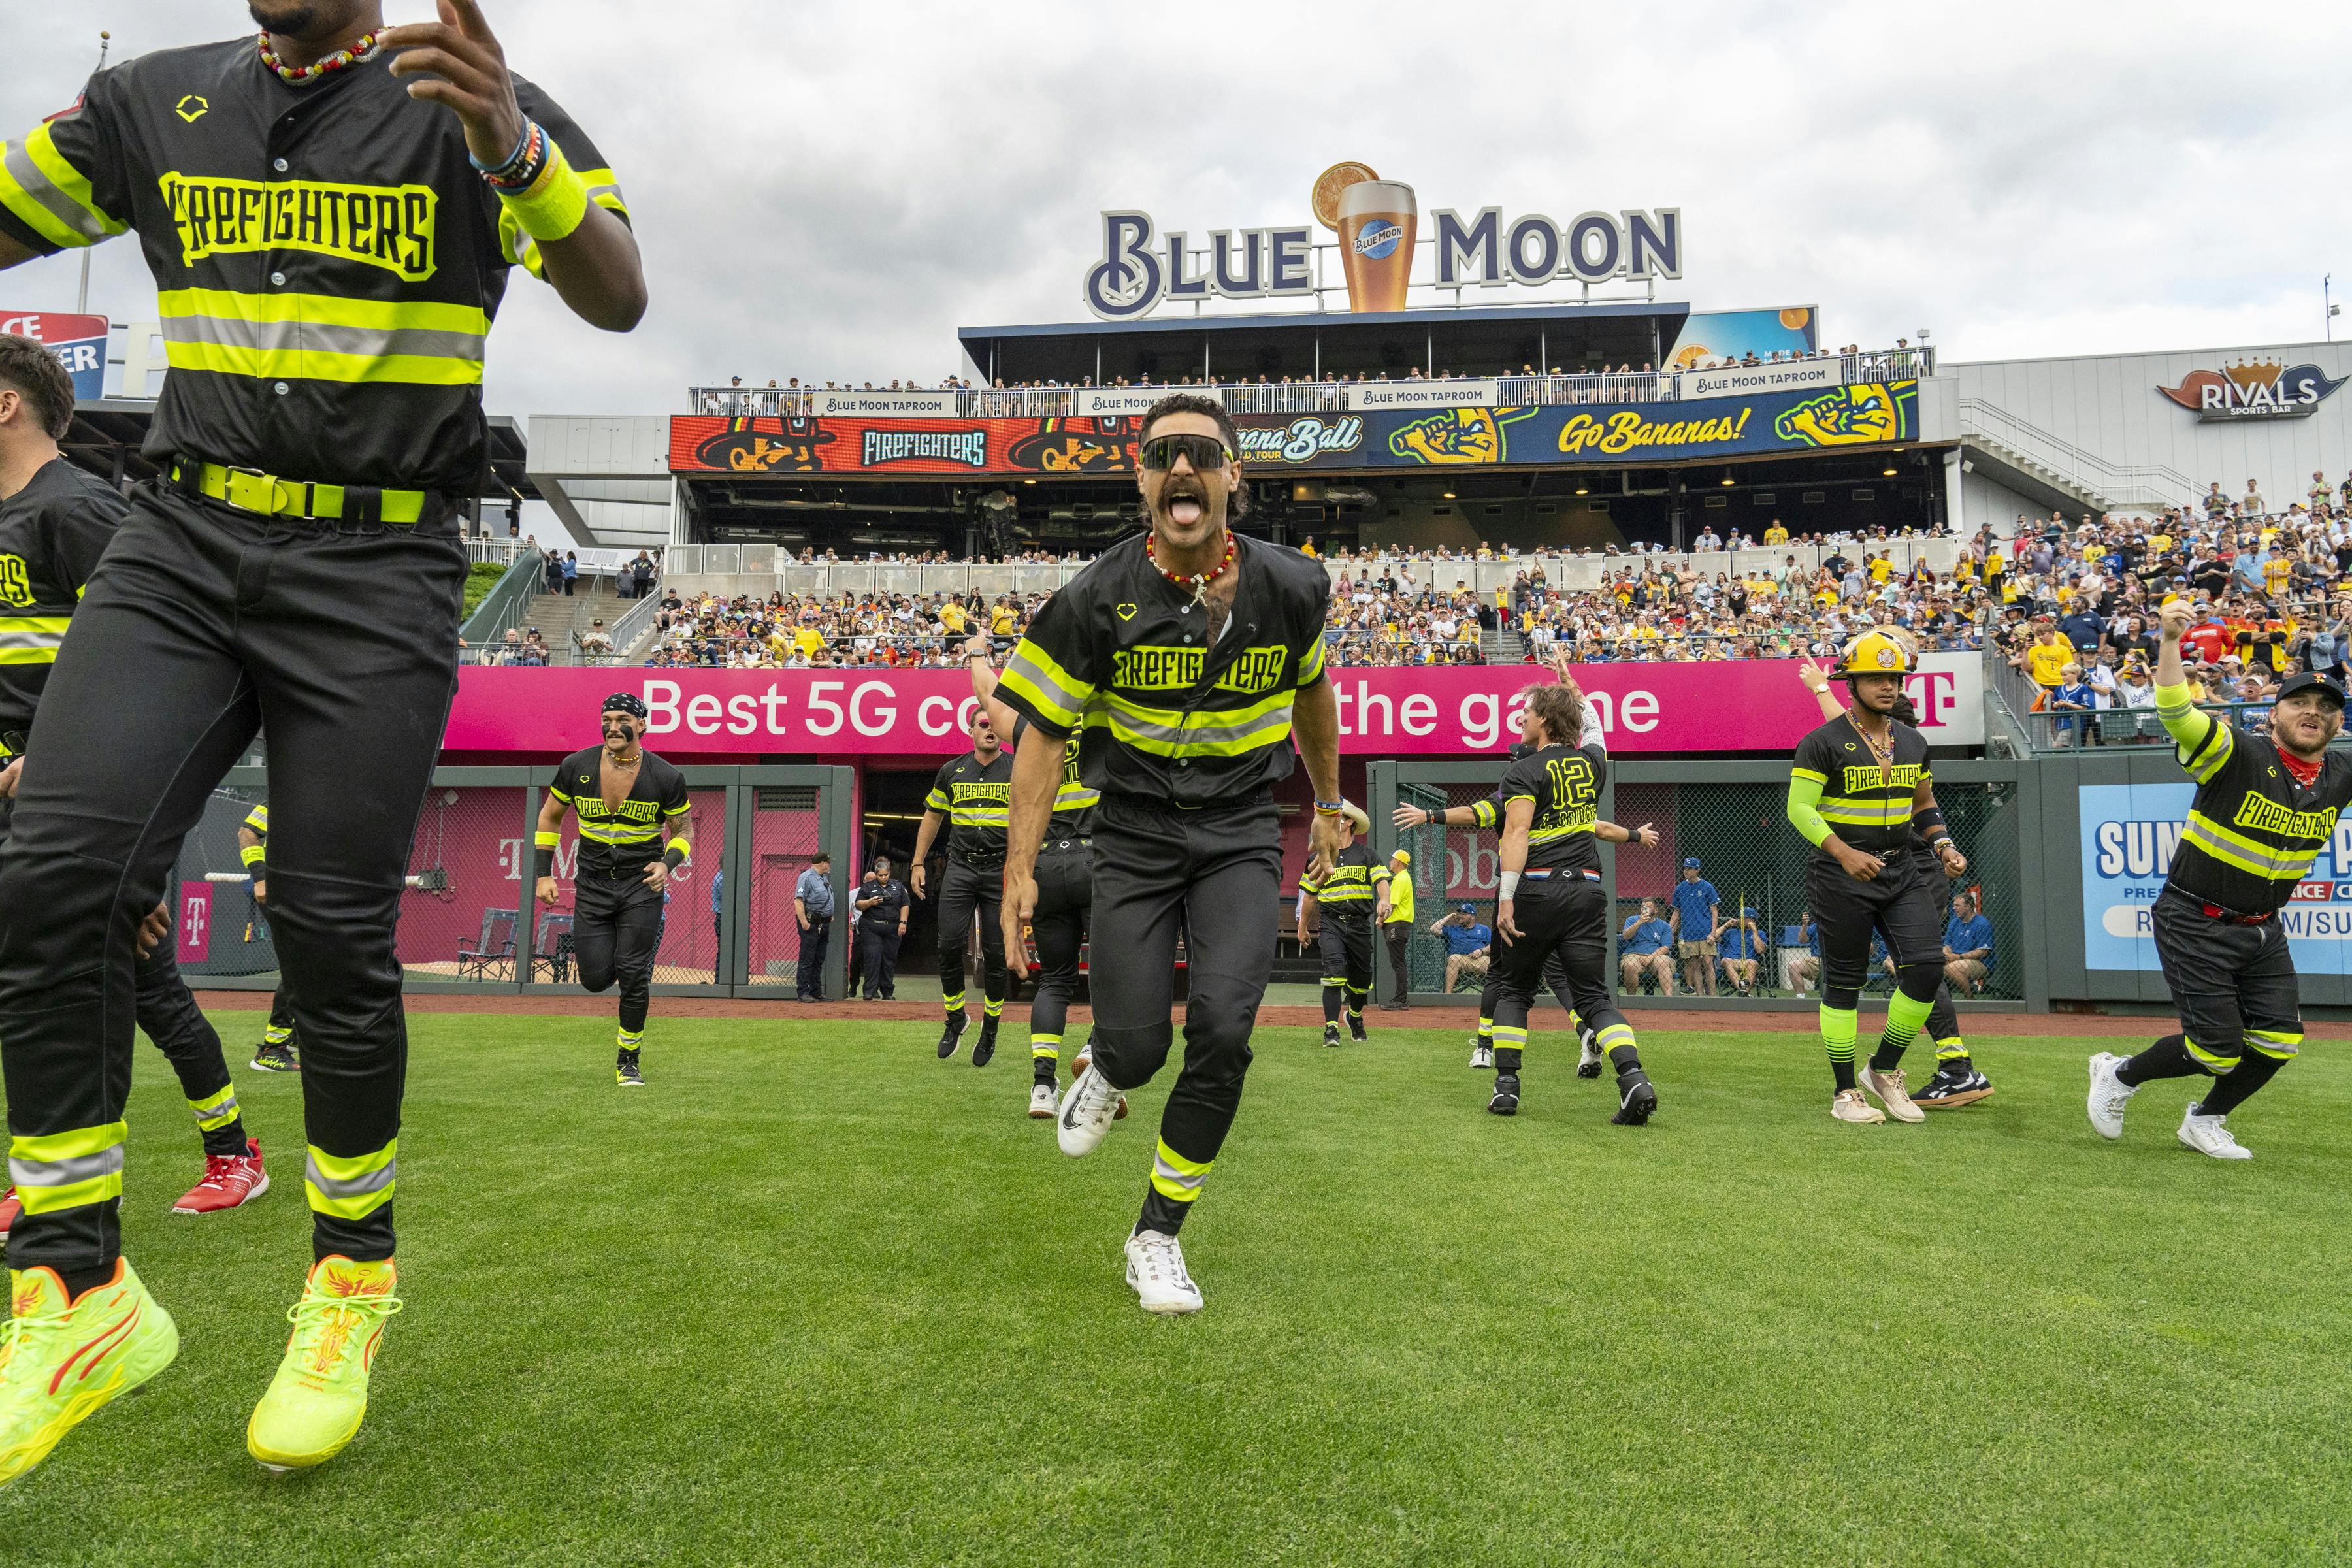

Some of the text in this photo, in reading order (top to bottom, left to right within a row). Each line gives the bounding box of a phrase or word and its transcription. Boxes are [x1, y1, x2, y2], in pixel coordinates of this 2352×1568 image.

[1355, 227, 1401, 253] BLUE MOON
[1083, 206, 1683, 321] BLUE MOON
[1697, 370, 1825, 393] BLUE MOON TAPROOM
[2202, 378, 2319, 409] RIVALS
[826, 398, 942, 412] BLUE MOON TAPROOM
[1092, 397, 1154, 410] BLUE MOON
[1364, 391, 1482, 405] BLUE MOON TAPROOM
[2230, 406, 2267, 416] SPORTS
[1283, 418, 1360, 461] Ball
[1558, 407, 1752, 454] Go Bananas!
[864, 431, 985, 466] FIREFIGHTERS
[1254, 450, 1282, 459] TOUR
[643, 679, 788, 735] Best
[805, 681, 897, 737] 5G
[1333, 680, 1437, 736] the
[1546, 757, 1596, 809] 12
